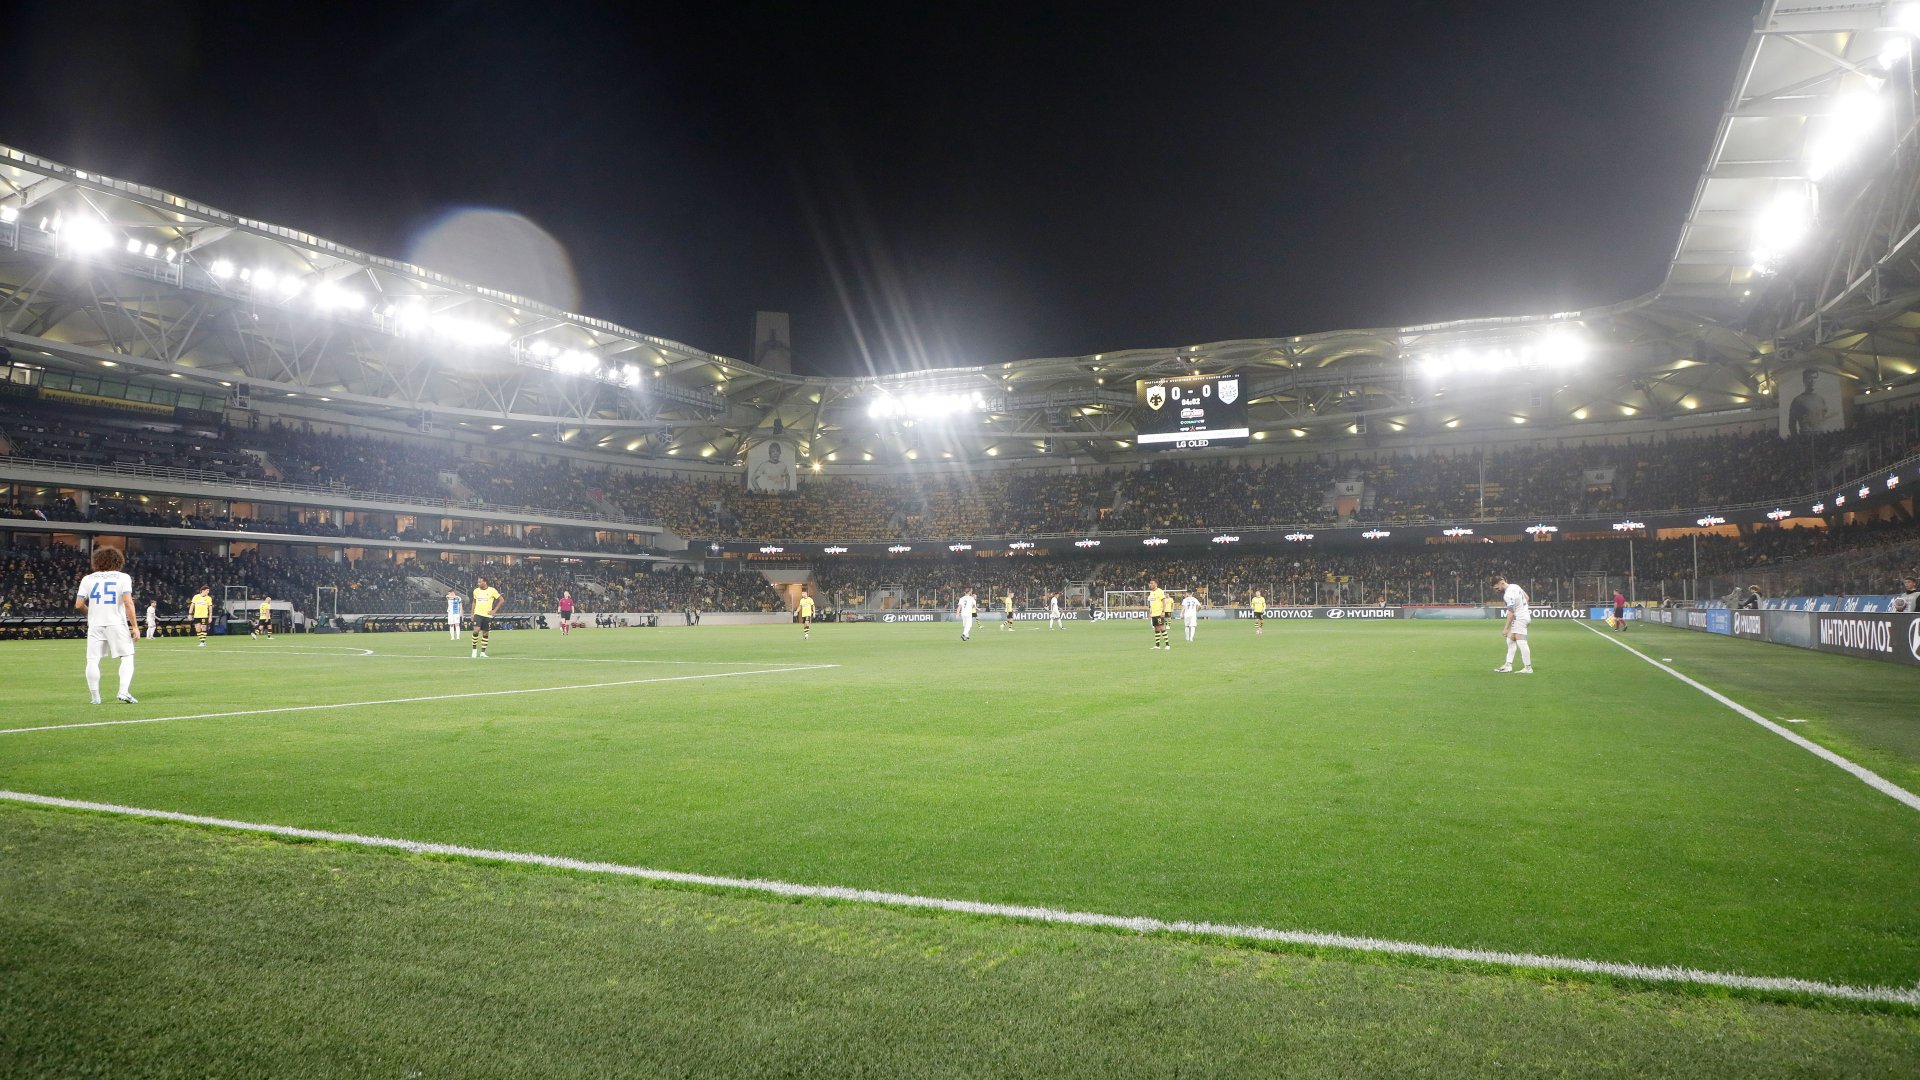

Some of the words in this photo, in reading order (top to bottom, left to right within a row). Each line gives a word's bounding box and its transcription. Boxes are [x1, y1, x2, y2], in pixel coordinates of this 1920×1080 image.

[1171, 386, 1181, 401] 0
[1202, 384, 1212, 398] 0
[1176, 440, 1187, 448] LG
[1188, 439, 1209, 448] OLED
[90, 581, 117, 605] 45
[898, 614, 934, 622] HYUNDAI
[1013, 612, 1078, 620] ΜΗΤΡΟΠΛΟΣ
[1107, 611, 1148, 619] HYUNDAI
[1347, 609, 1395, 618] HYUNDAI
[1820, 618, 1893, 653] ΜΗΤΡΟΠΟΥΛΟΣ
